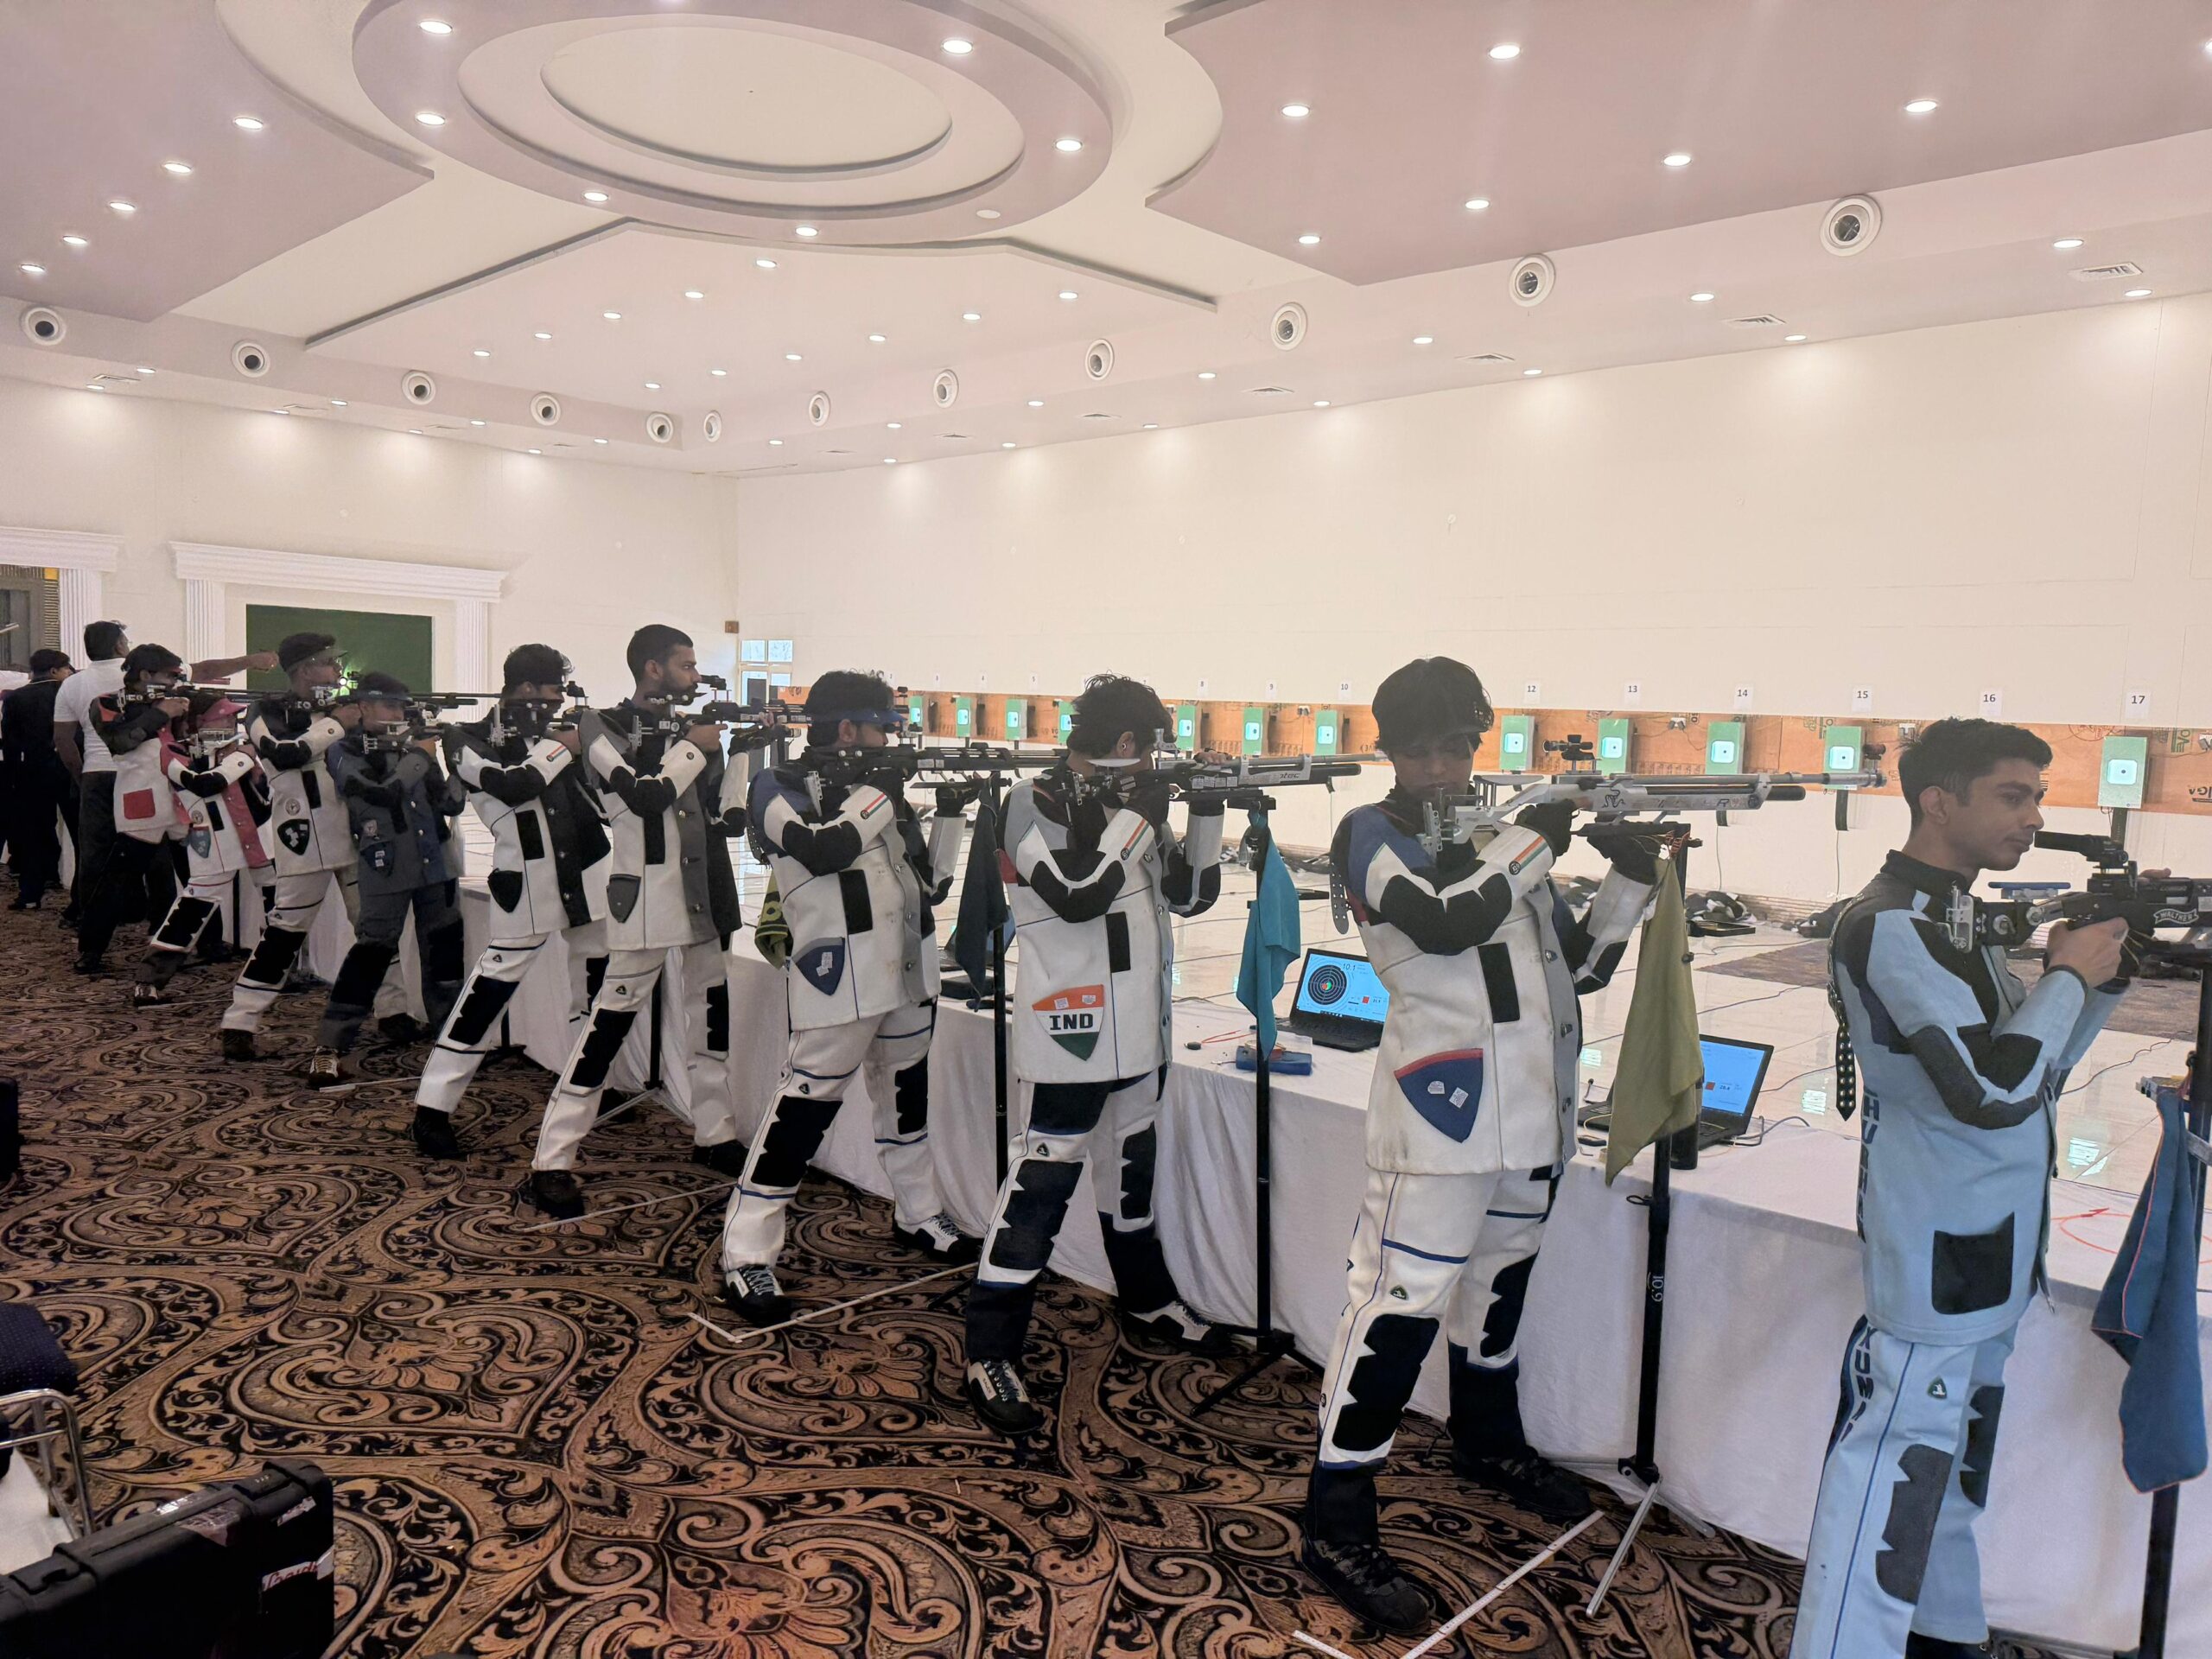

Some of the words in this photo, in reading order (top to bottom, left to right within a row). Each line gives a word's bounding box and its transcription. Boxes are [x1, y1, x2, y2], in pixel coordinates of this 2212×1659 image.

[1737, 689, 1748, 697] 14
[1857, 690, 1869, 699] 15
[1983, 694, 1996, 702] 16
[2131, 695, 2145, 704] 17
[2160, 911, 2193, 922] WALTHER
[1049, 1013, 1094, 1031] IND
